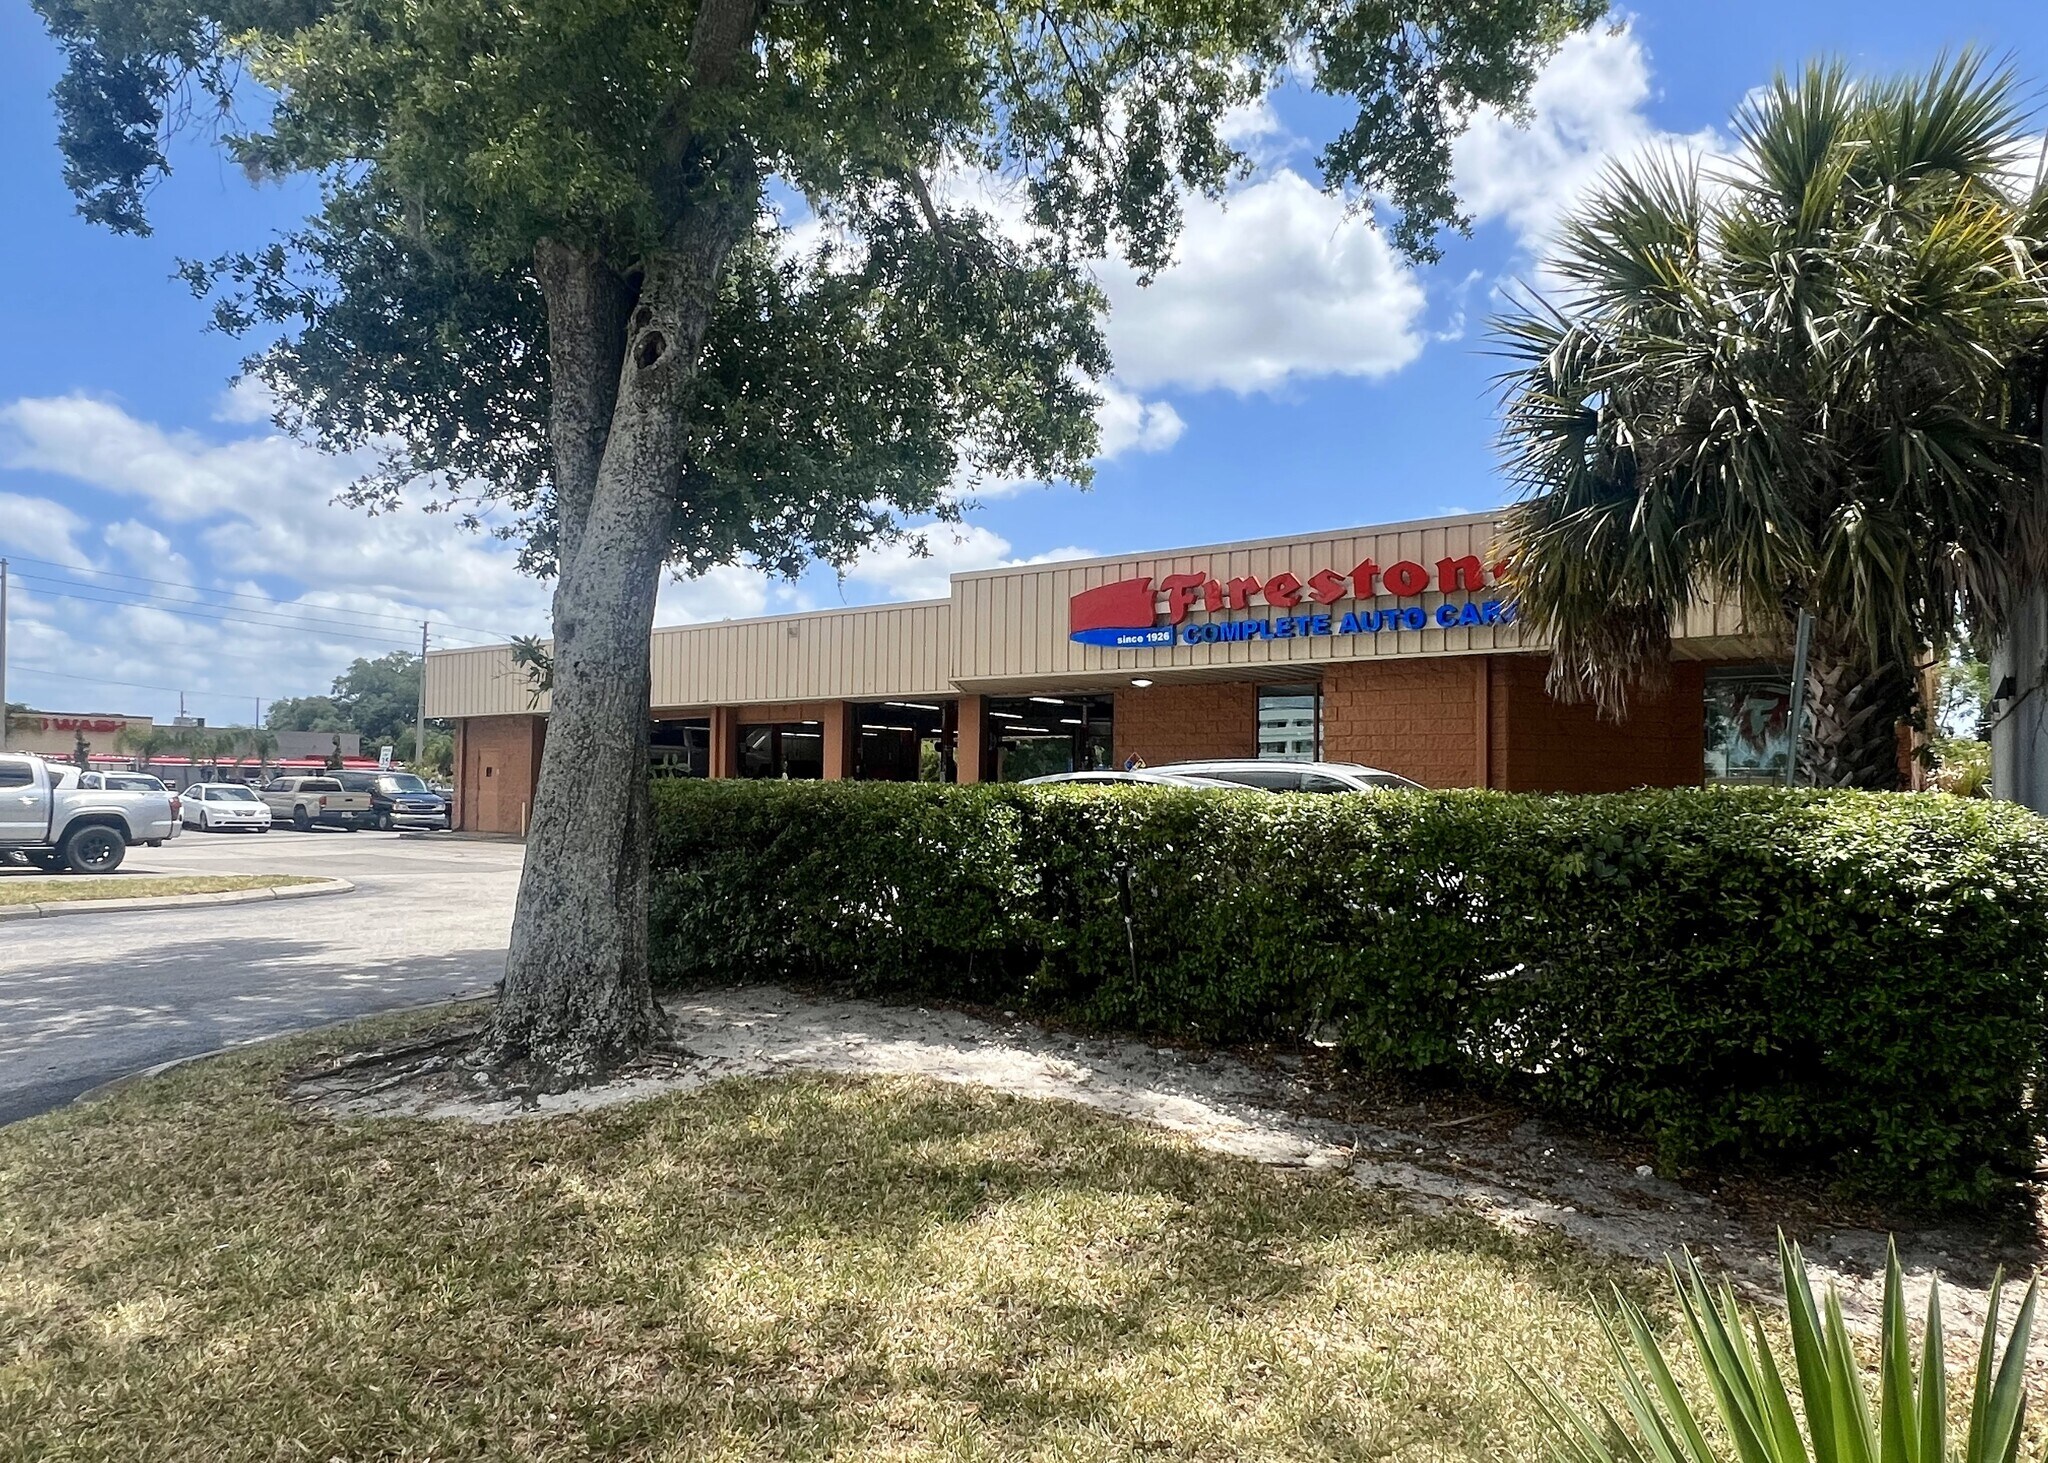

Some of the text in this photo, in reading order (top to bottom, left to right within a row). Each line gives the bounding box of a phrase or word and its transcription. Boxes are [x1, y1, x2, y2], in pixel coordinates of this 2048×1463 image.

[1117, 631, 1170, 645] since 1926
[1183, 613, 1332, 645] COMPLETE
[1339, 606, 1428, 634] AUTO
